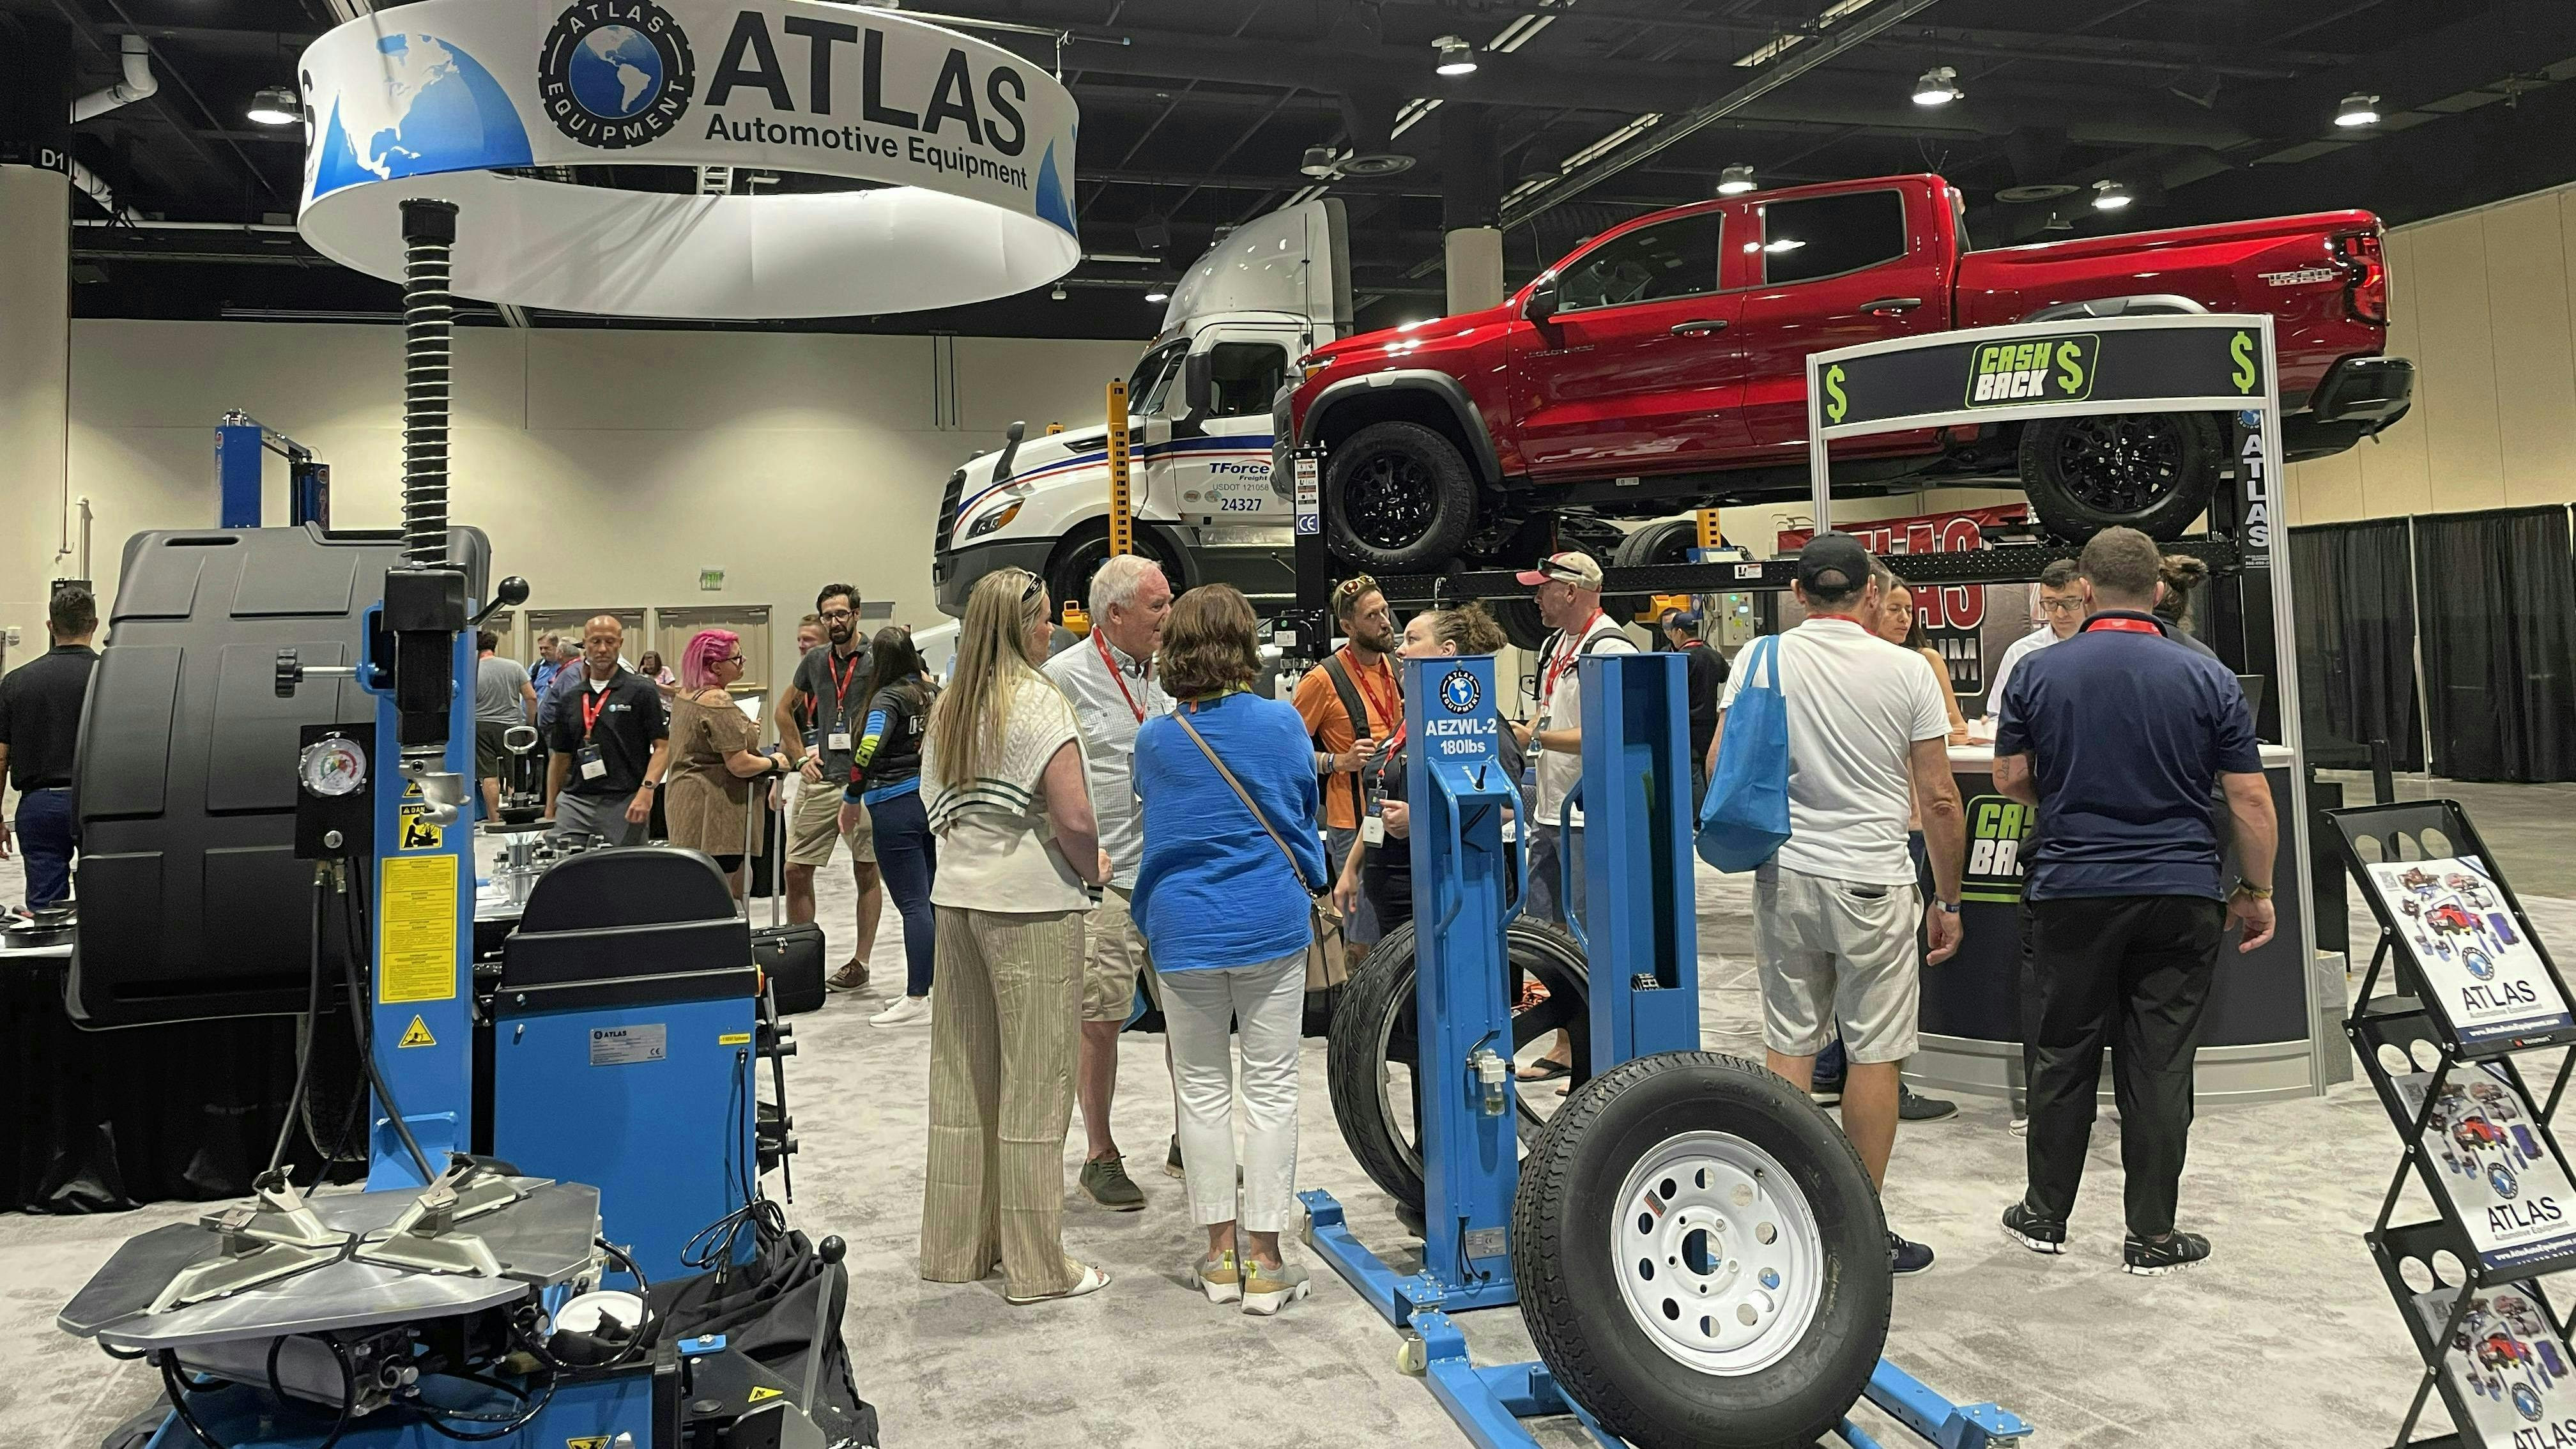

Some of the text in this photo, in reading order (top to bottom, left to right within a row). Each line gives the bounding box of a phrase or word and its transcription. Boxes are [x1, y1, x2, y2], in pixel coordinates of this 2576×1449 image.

[570, 2, 663, 33] ATLAS
[704, 10, 1025, 157] ATLAS
[548, 80, 684, 141] EQUIPMENT
[42, 149, 63, 170] D1
[705, 113, 1028, 191] Automotive Equipment
[1980, 342, 2053, 374] CASH
[2057, 341, 2083, 394] $
[2230, 331, 2255, 394] $
[1826, 364, 1847, 424] $
[1974, 369, 2049, 401] BACK
[1209, 463, 1269, 474] TForce
[1221, 498, 1262, 511] 24327
[2241, 434, 2270, 548] ATLAS
[319, 487, 328, 531] ATLA
[1299, 516, 1316, 532] CE
[1448, 671, 1475, 682] ATLAS
[1442, 693, 1480, 712] EQUIPMENT
[1425, 718, 1497, 736] AEZWL-2
[1440, 739, 1486, 755] 180lbs
[1975, 804, 2035, 839] CA
[1968, 839, 2024, 876] BA
[2462, 980, 2536, 1011] ATLAS
[2487, 1197, 2563, 1232] ATLAS
